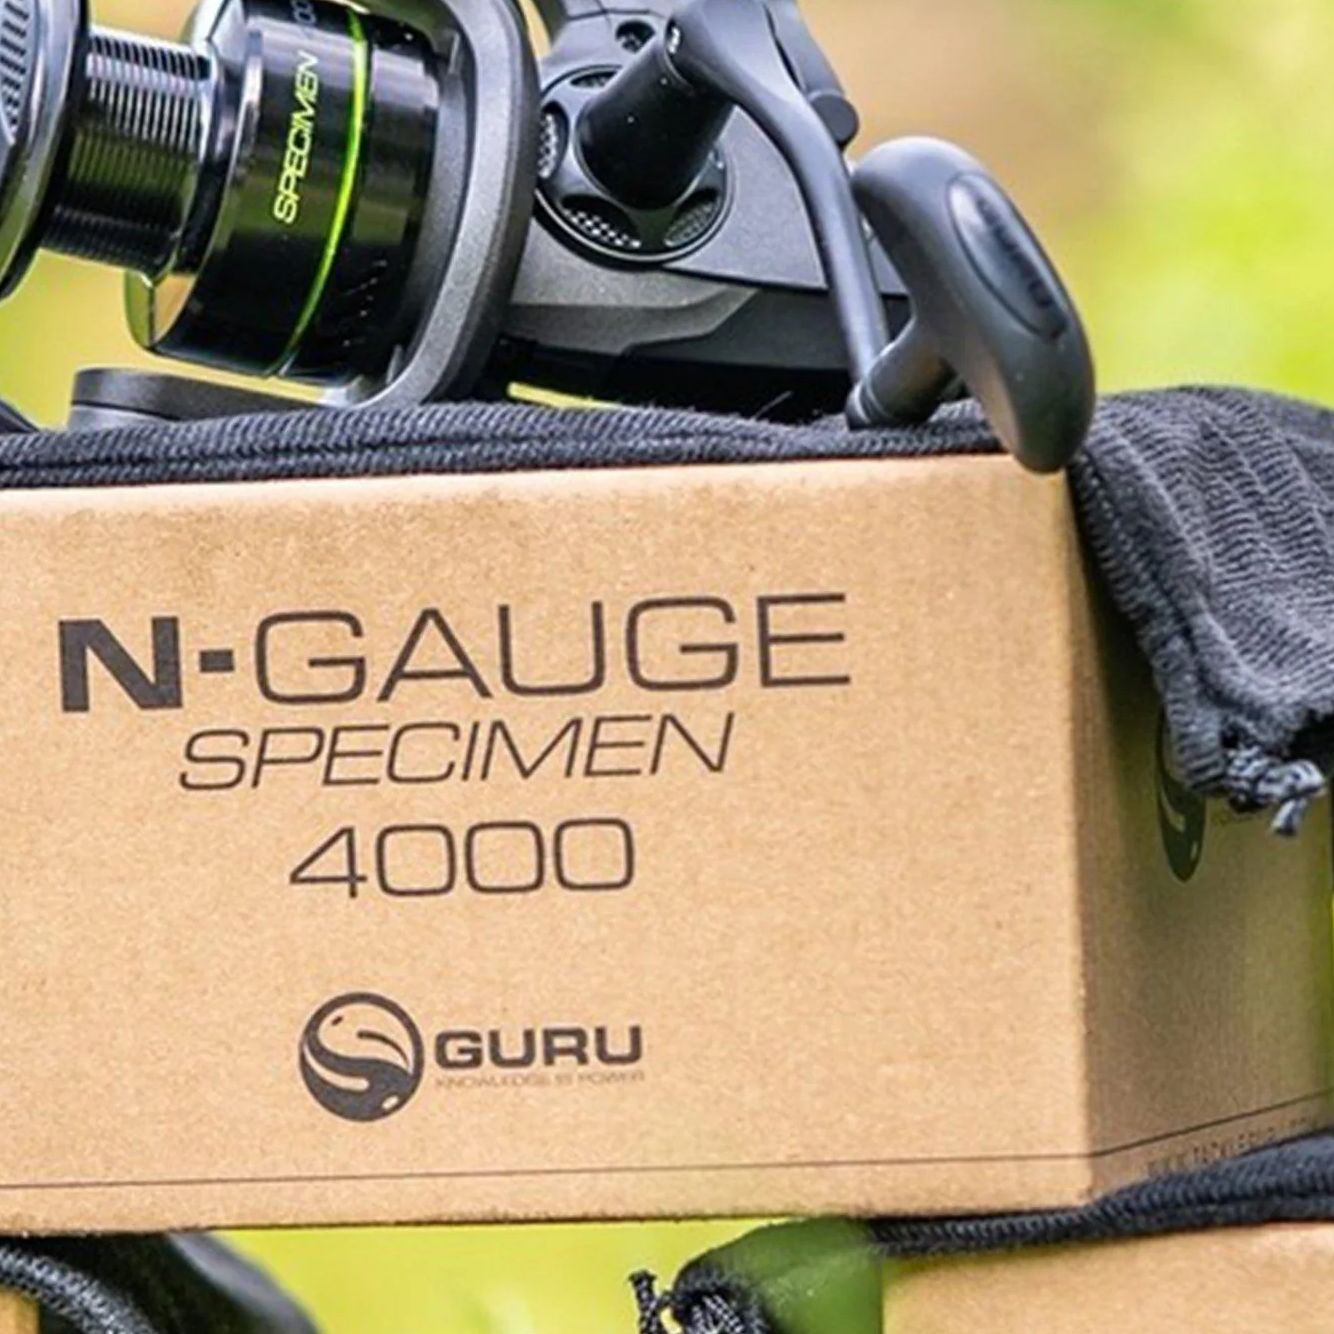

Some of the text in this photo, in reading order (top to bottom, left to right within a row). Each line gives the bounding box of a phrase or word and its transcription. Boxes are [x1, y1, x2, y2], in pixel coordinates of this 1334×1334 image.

[273, 50, 318, 224] SPECIMEN
[58, 593, 852, 714] N-GAUGE
[178, 713, 735, 791] SPECIMEN
[289, 817, 635, 900] 4000
[434, 1024, 643, 1070] GURU
